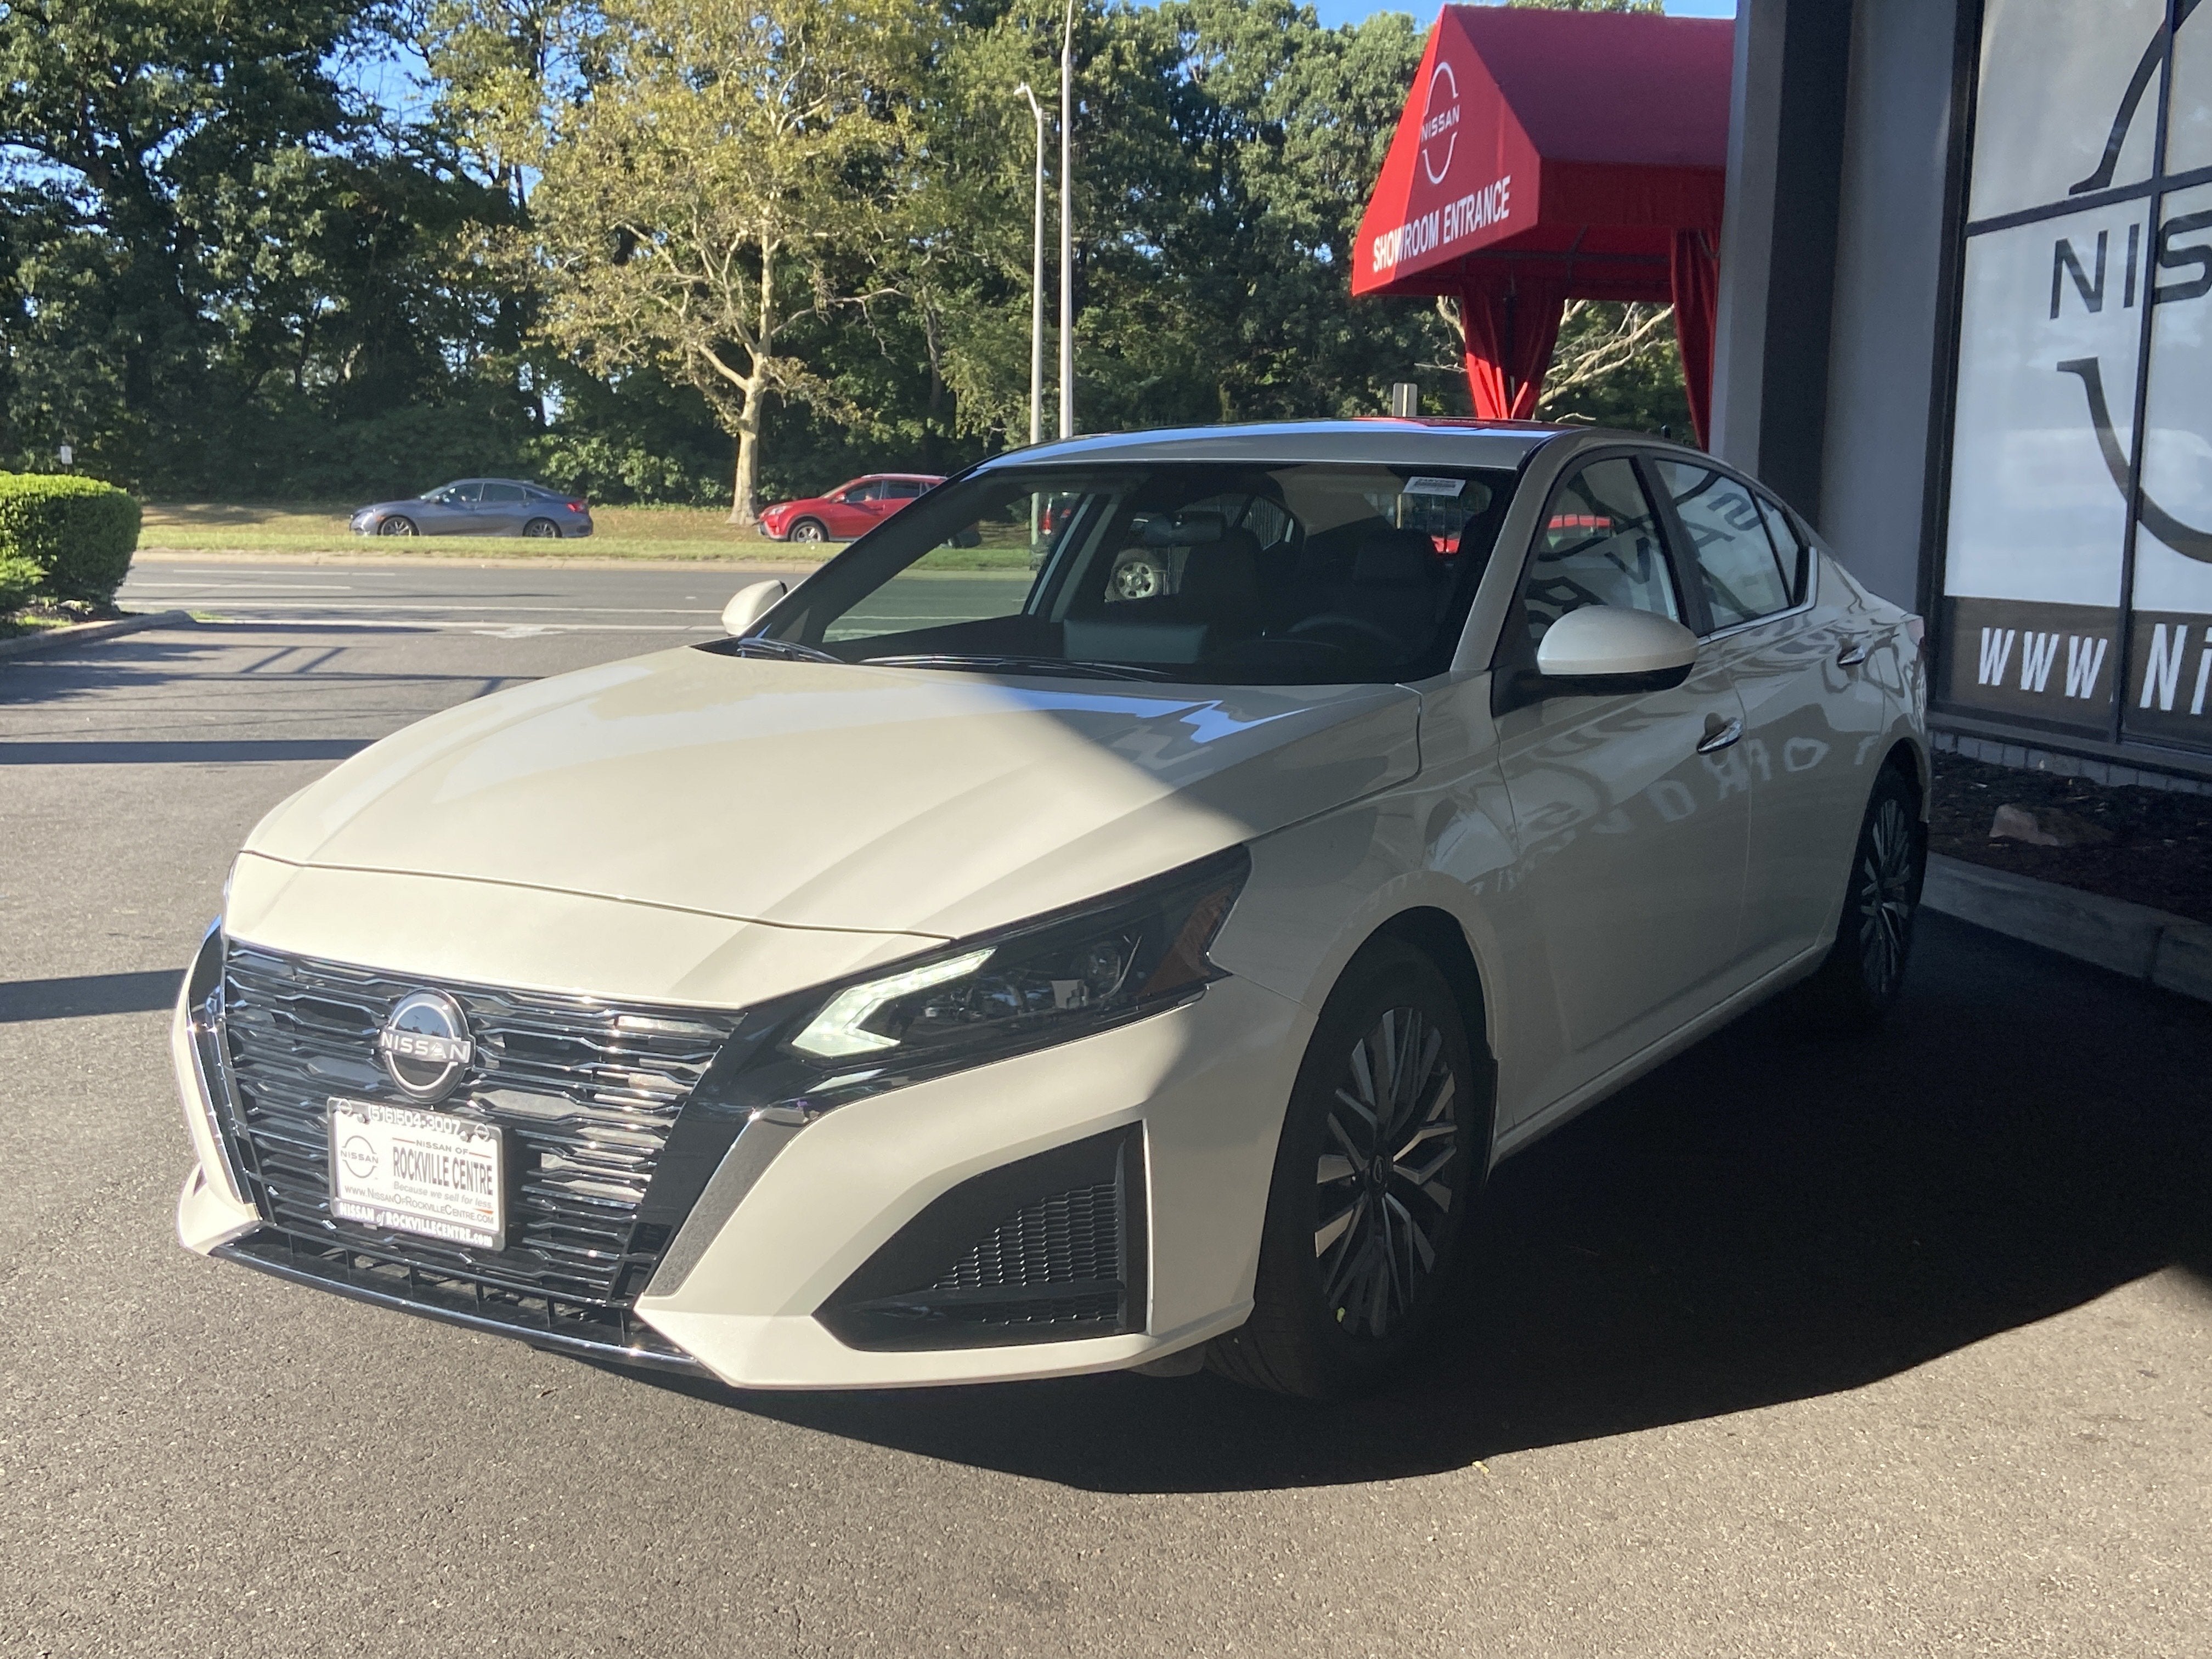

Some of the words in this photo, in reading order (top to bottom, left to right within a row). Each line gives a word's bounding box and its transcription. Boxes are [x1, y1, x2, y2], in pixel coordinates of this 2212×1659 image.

[1421, 104, 1460, 142] NISSAN
[1373, 210, 1440, 272] SHOWROOM
[1443, 175, 1511, 244] ENTRANCE
[381, 1031, 467, 1061] NISSAN
[340, 1150, 379, 1164] NISSAN
[416, 1139, 452, 1152] NISSAN
[393, 1146, 450, 1187] ROCKVILLE
[452, 1157, 493, 1196] CENTRE
[394, 1181, 428, 1196] Because
[430, 1190, 442, 1199] we
[444, 1192, 460, 1202] sell
[461, 1194, 473, 1204] for
[339, 1202, 374, 1222] NISSAN
[376, 1211, 385, 1227] of
